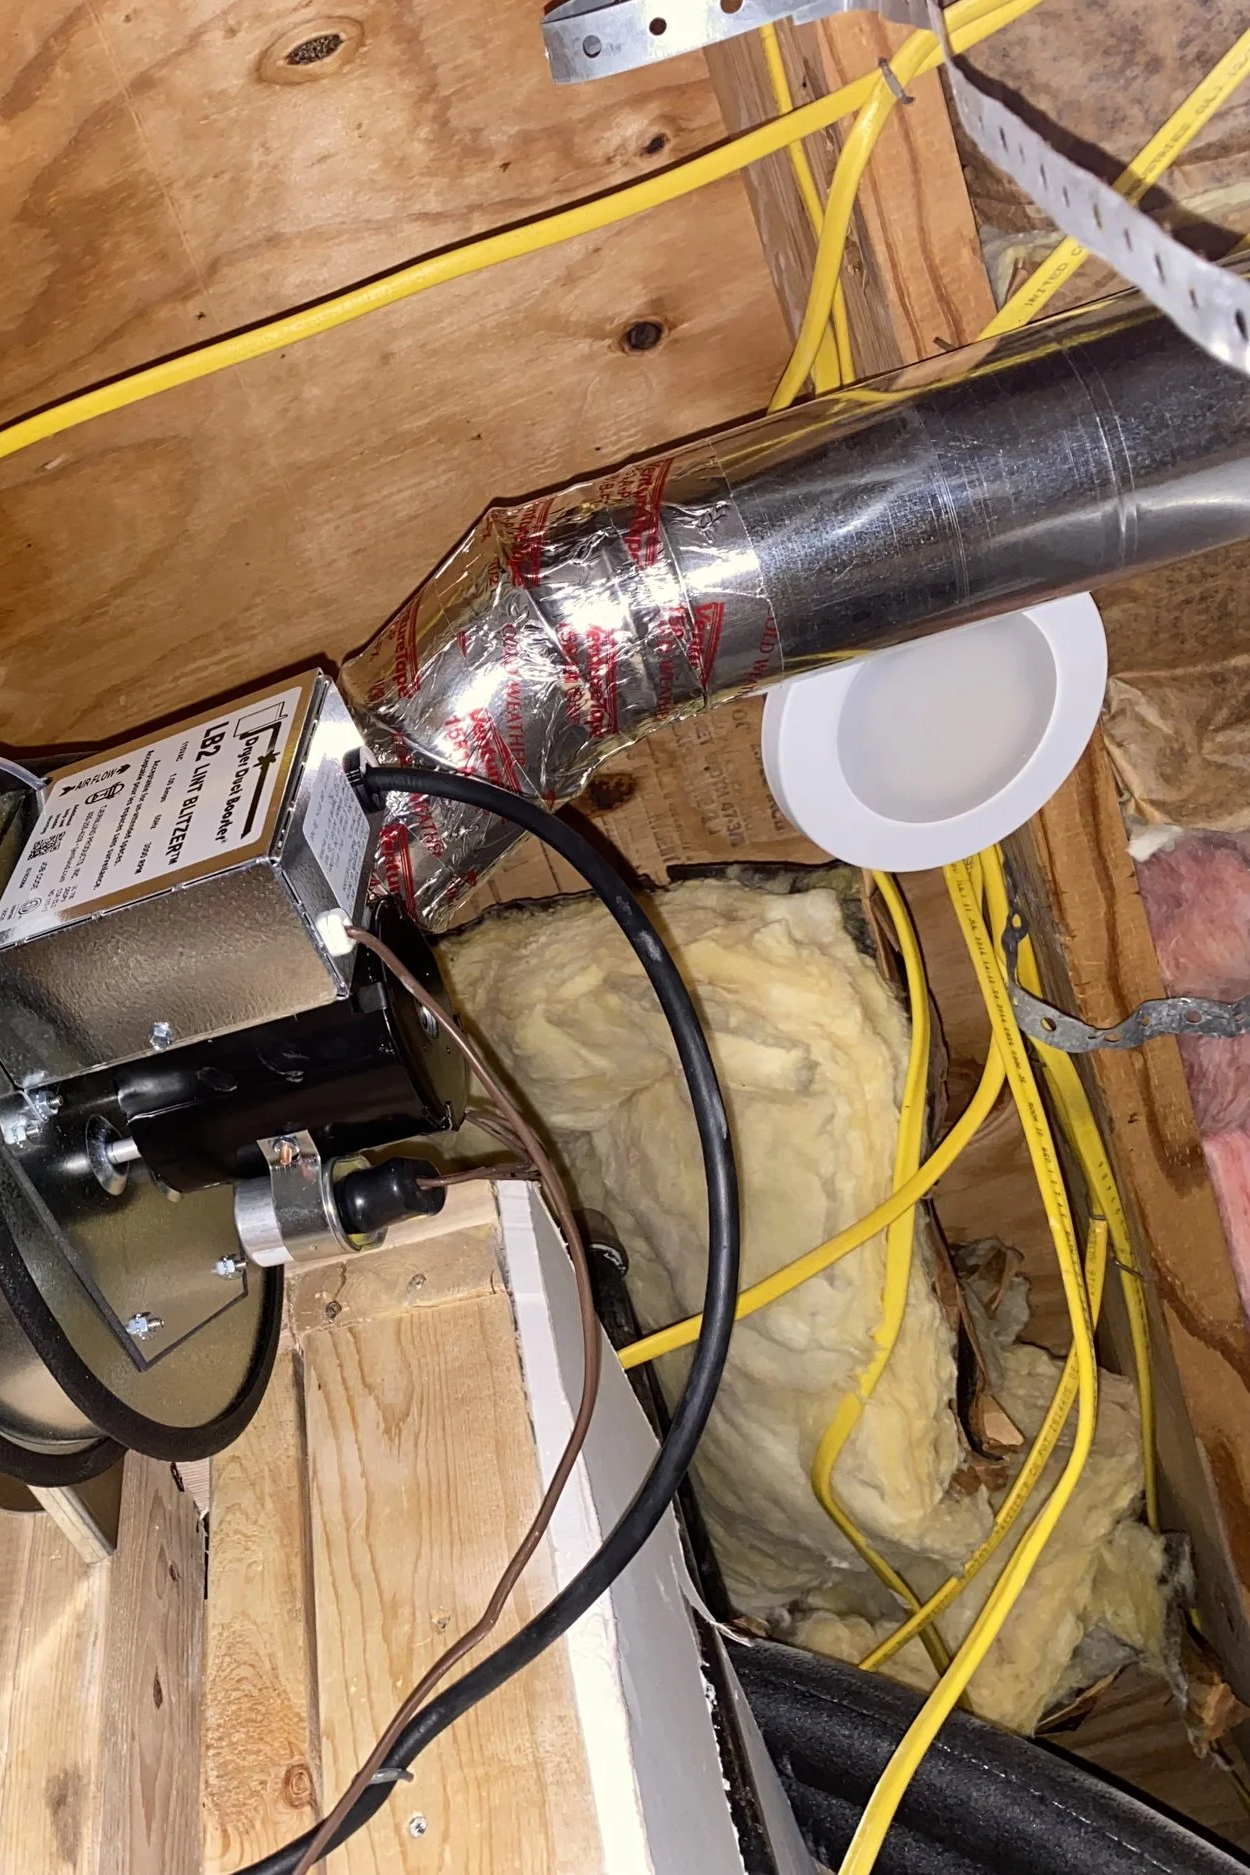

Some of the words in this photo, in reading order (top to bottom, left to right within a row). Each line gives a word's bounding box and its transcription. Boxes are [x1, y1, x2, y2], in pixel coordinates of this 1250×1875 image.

[195, 720, 229, 762] LB2
[236, 736, 259, 769] Dryer
[141, 759, 161, 793] Acceptable
[187, 763, 210, 794] LINT
[229, 767, 249, 797] Duct
